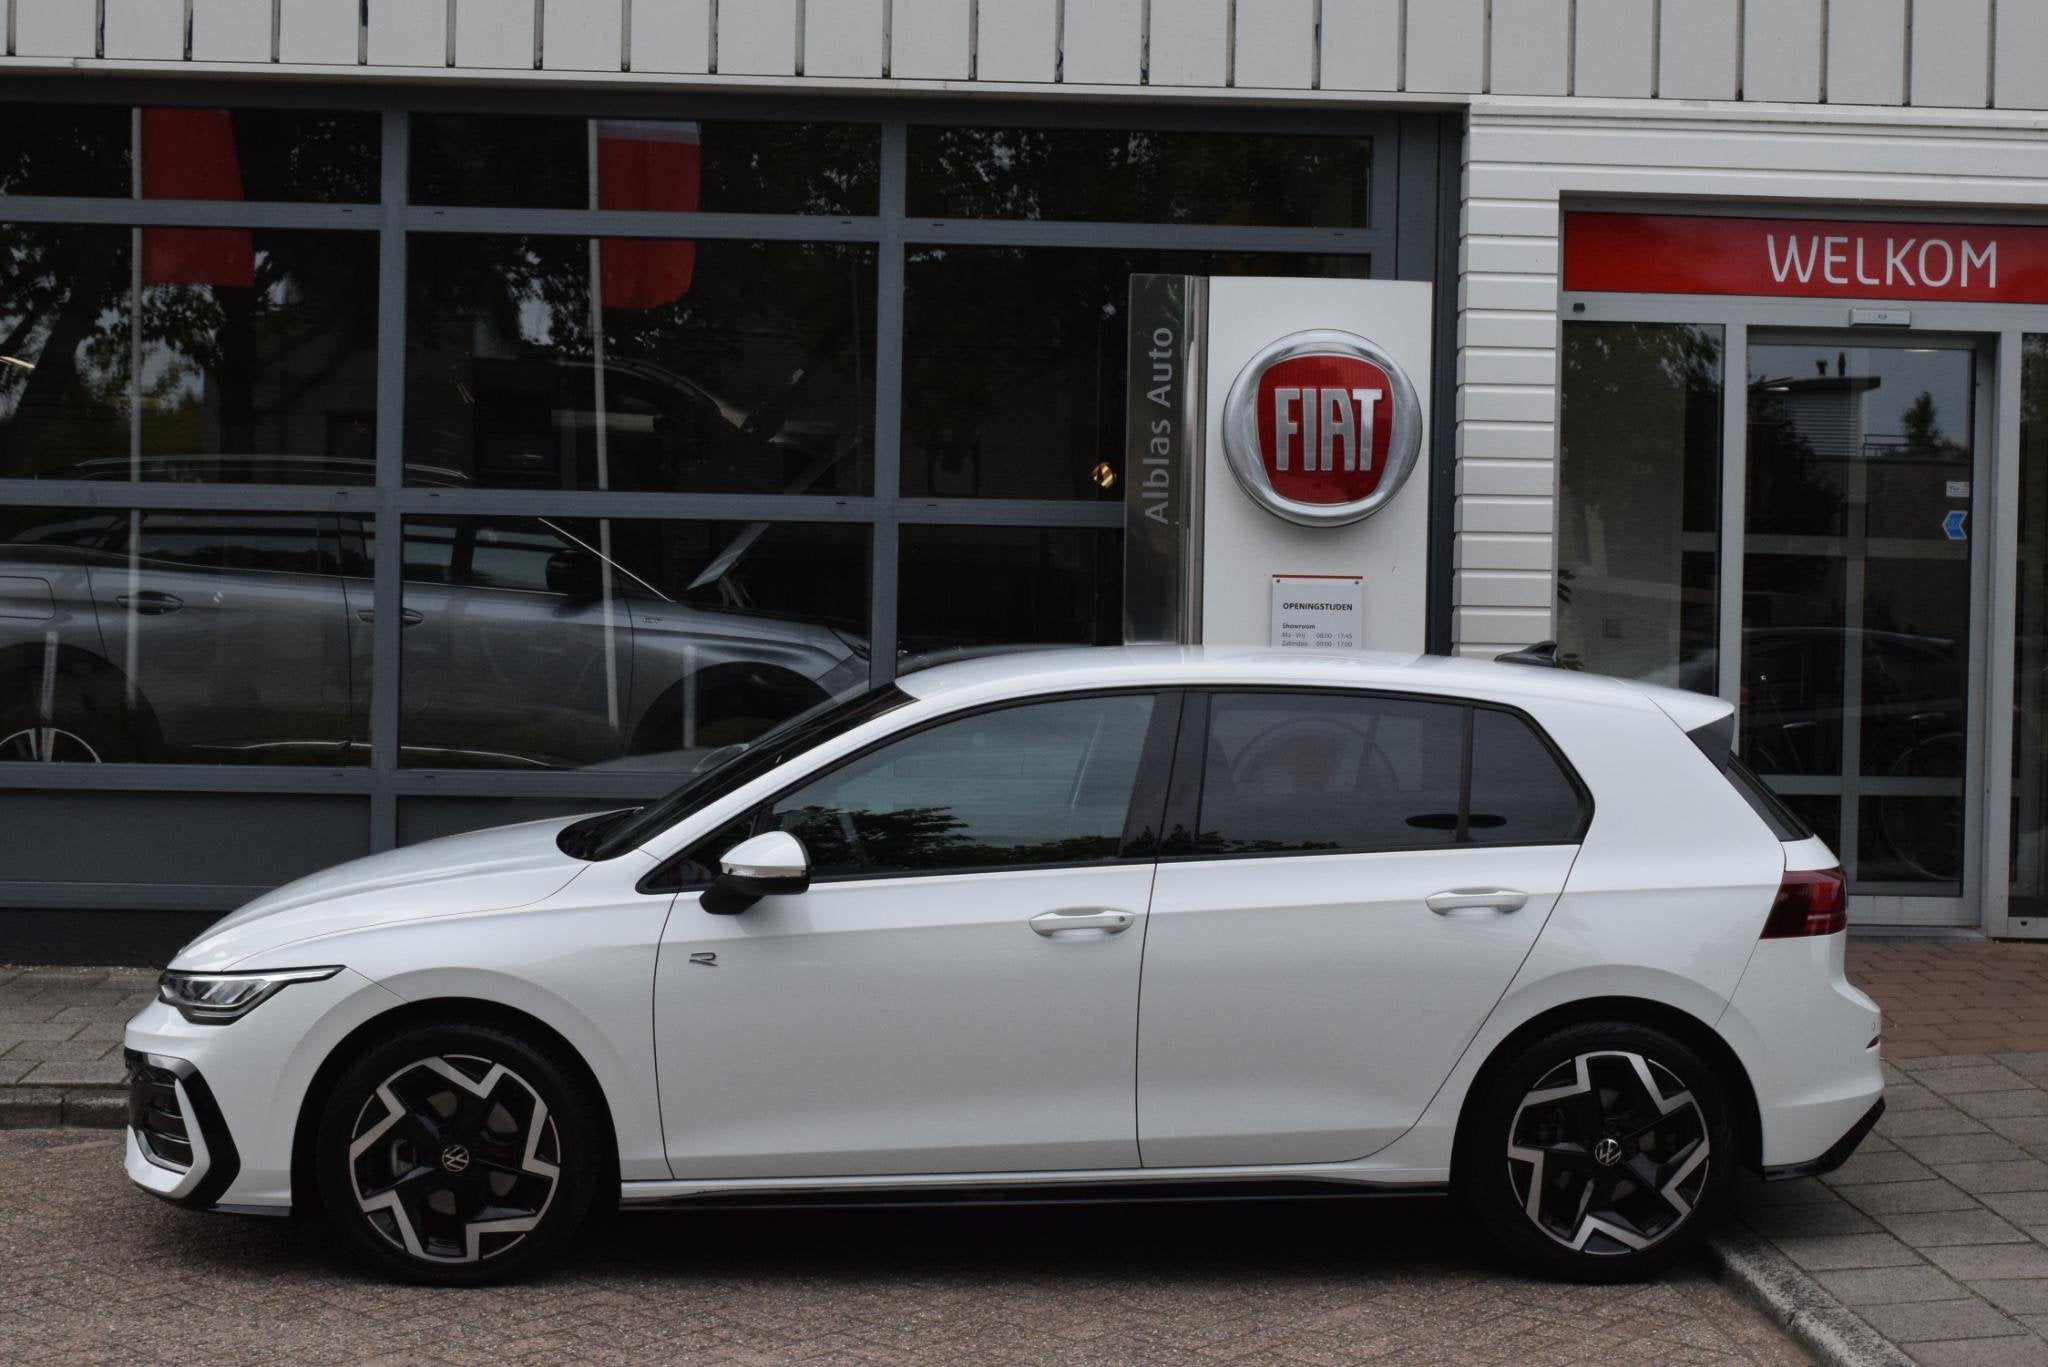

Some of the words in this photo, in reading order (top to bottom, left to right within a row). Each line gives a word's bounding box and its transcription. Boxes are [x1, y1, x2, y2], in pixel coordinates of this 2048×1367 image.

[1766, 233, 1998, 289] WELKOM
[1146, 326, 1174, 407] Auto
[1274, 387, 1383, 472] FIAT
[1142, 419, 1171, 525] Alblas
[1282, 622, 1316, 630] Showroom
[1283, 602, 1353, 611] OPENINGSTIJDEN
